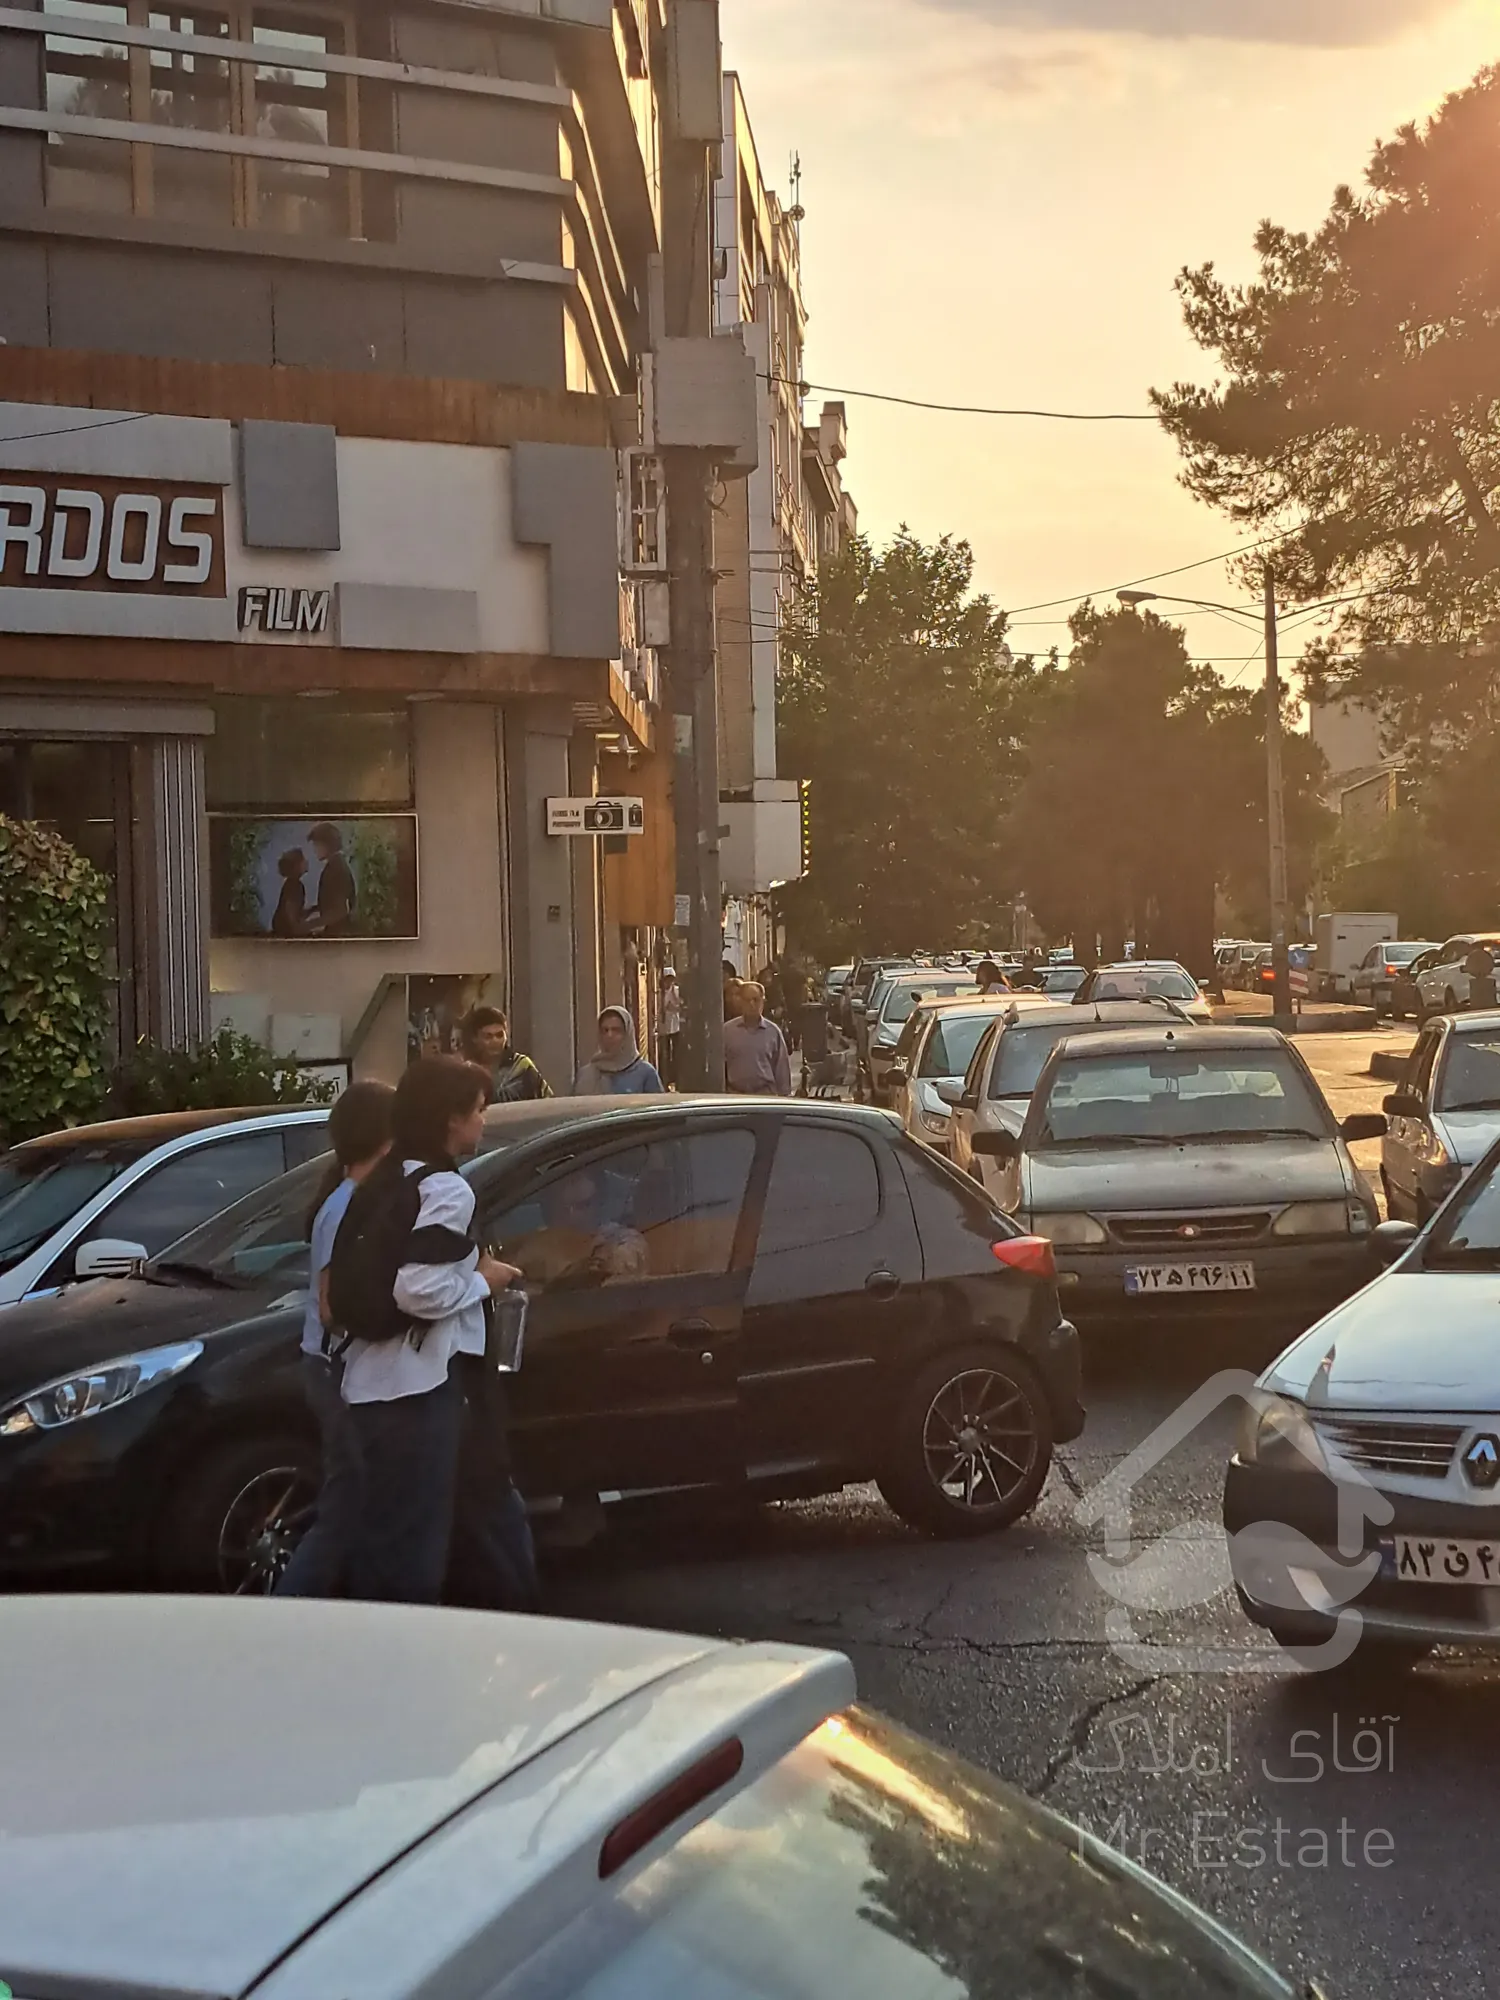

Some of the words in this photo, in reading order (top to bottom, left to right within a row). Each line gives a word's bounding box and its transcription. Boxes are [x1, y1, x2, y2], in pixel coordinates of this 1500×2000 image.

[0, 485, 217, 583] RDOS
[239, 587, 330, 631] FILM
[1476, 1545, 1500, 1580] ۴
